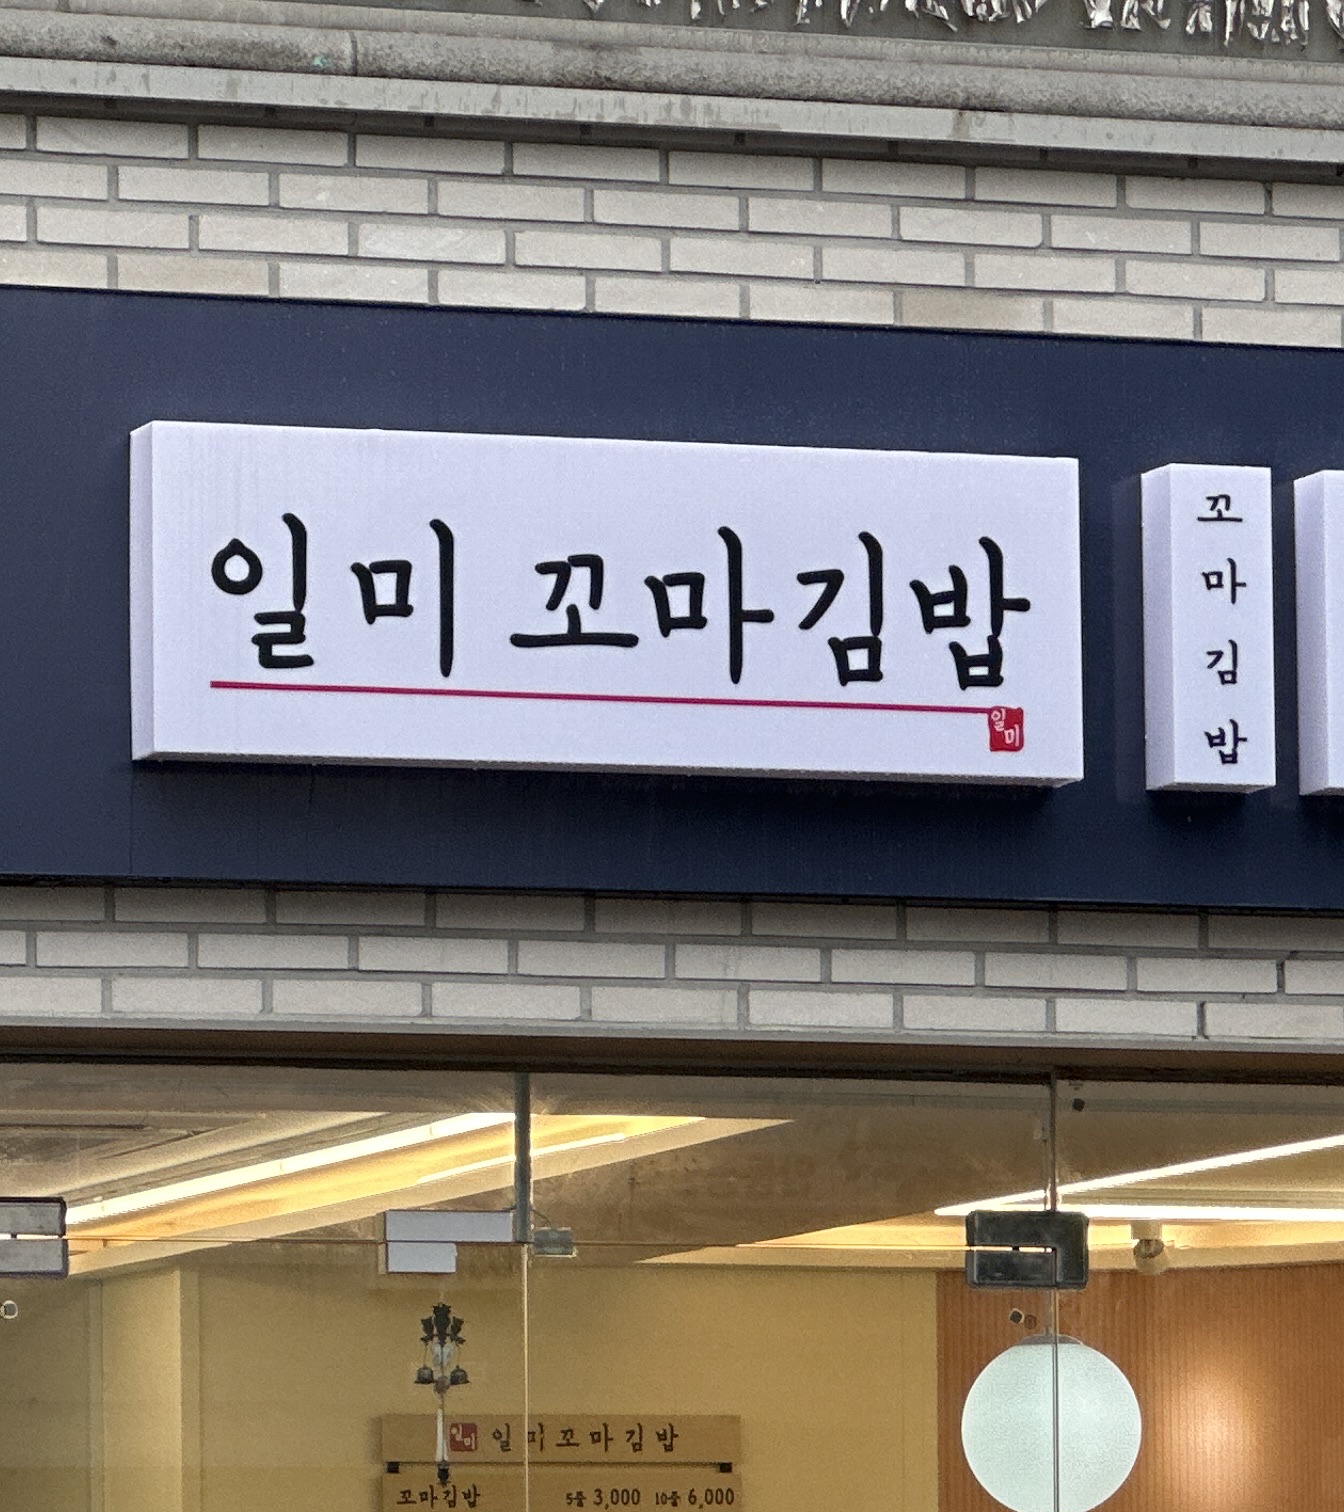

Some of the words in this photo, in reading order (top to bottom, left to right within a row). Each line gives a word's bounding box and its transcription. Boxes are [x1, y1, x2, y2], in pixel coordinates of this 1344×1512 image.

[210, 512, 456, 679] 일미
[509, 525, 1032, 690] 꼬마김밥
[1197, 493, 1247, 766] 꼬마김밥
[990, 707, 1021, 748] 일미
[397, 1484, 481, 1510] 꼬마김밥
[593, 1488, 641, 1510] 3,000
[688, 1488, 735, 1510] 6,000
